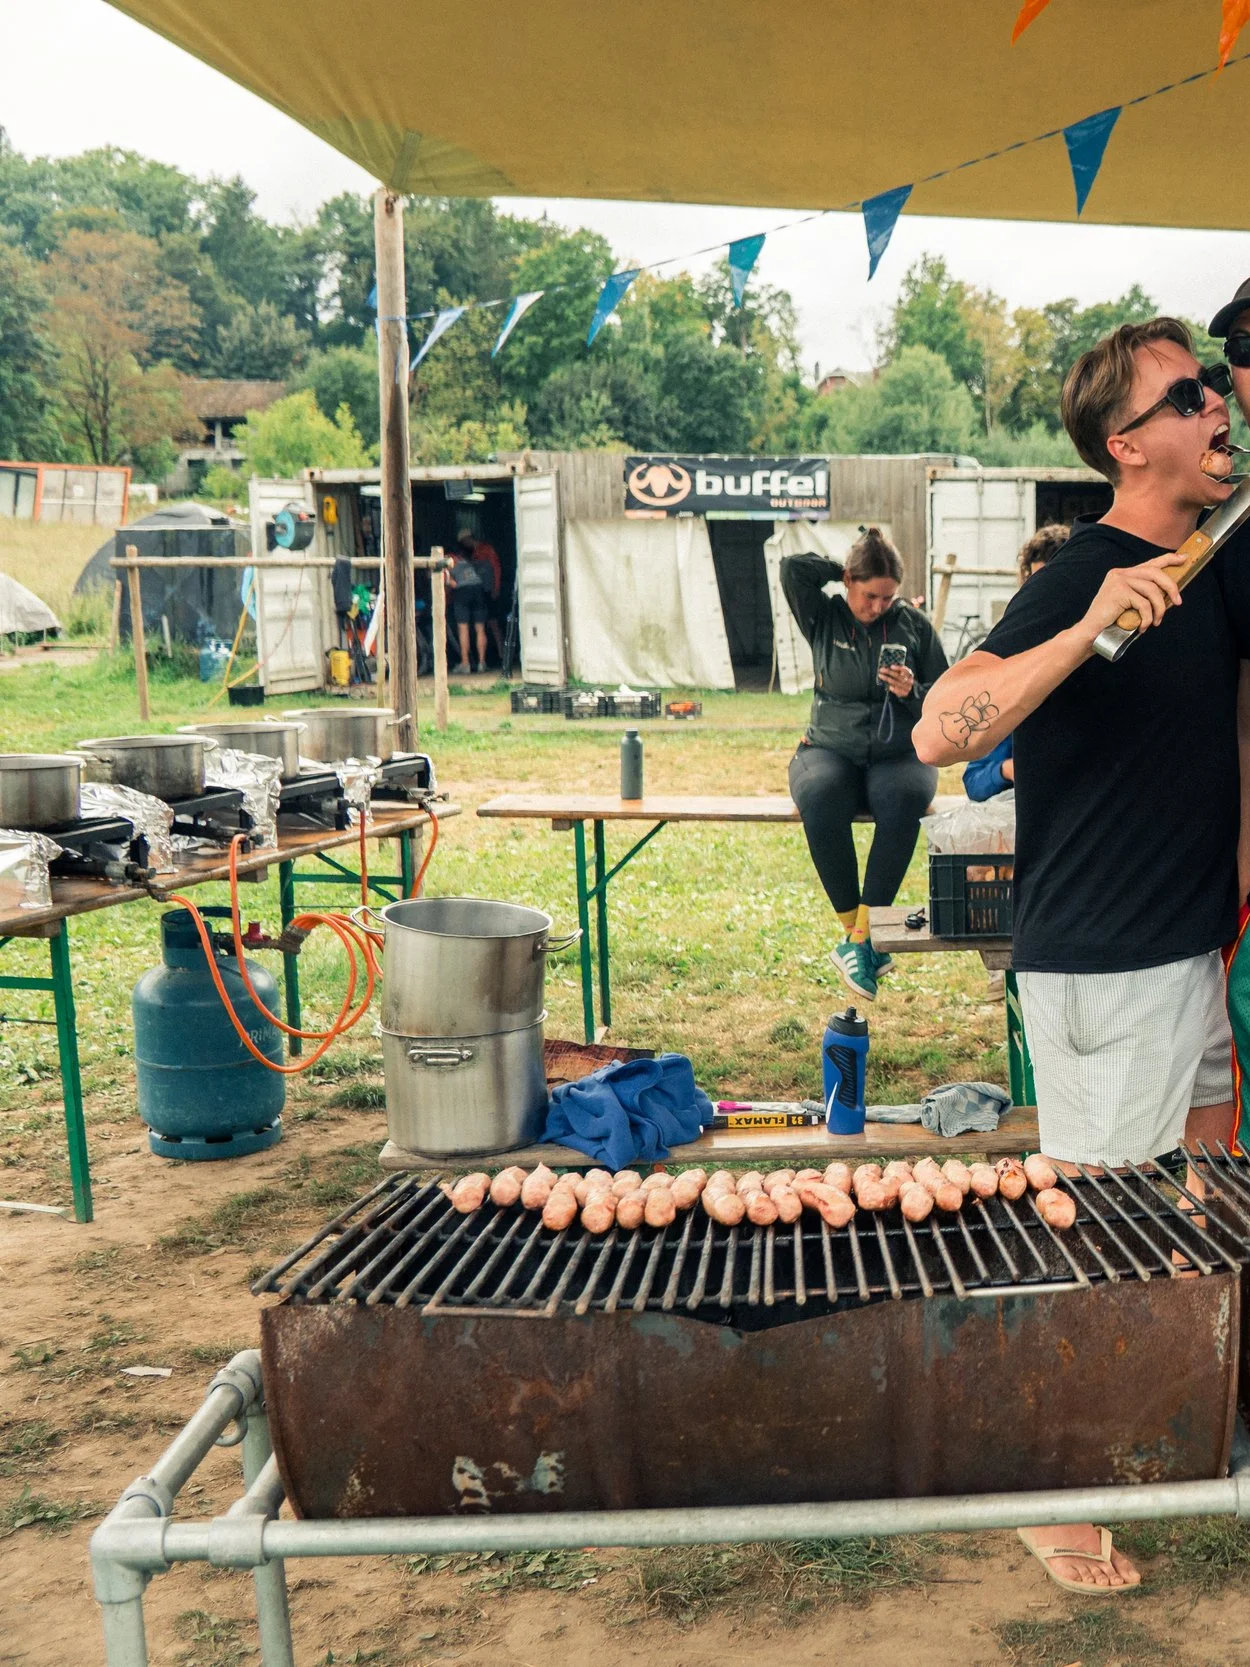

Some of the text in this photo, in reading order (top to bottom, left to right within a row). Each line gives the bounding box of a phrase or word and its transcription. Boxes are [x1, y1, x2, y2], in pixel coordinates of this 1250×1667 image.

[695, 469, 827, 496] buffel
[734, 1116, 785, 1126] FLAMAX
[791, 1115, 804, 1126] 32
